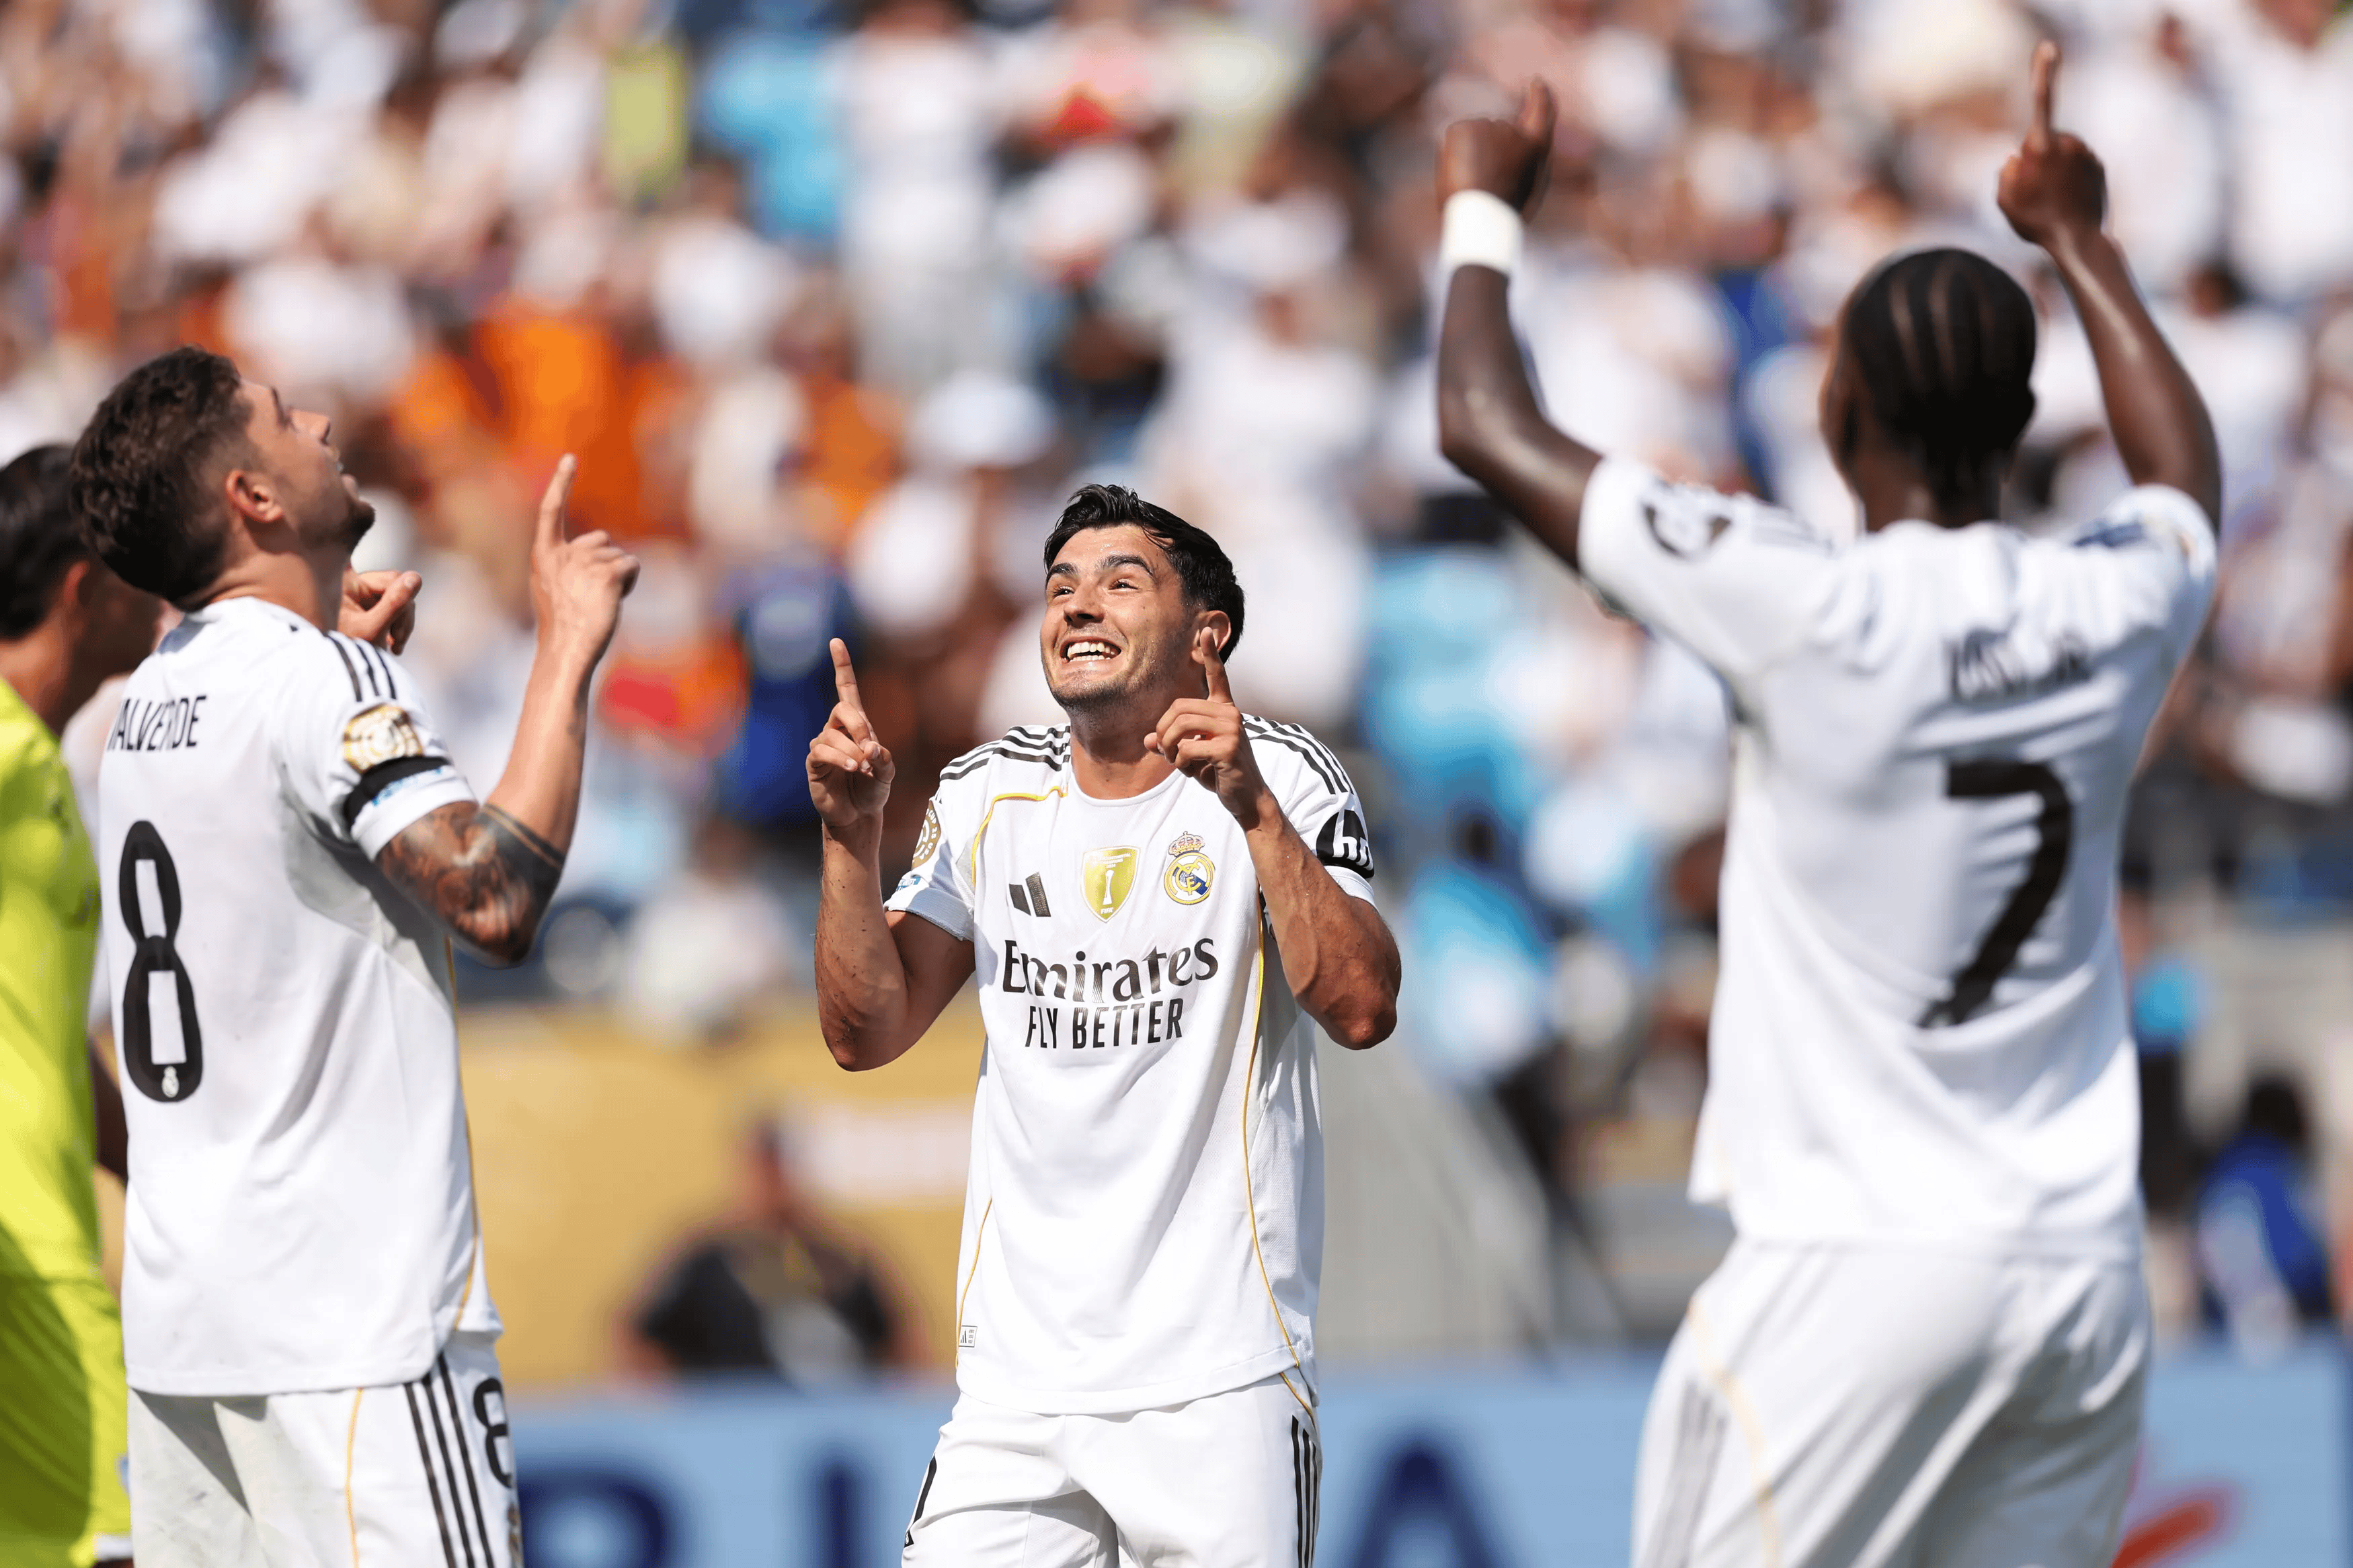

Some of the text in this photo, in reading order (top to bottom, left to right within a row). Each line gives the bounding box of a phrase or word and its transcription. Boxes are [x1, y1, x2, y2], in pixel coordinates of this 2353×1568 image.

[1101, 907, 1114, 915] FIFA
[1915, 759, 2073, 1028] 7
[120, 820, 202, 1102] 8
[1002, 938, 1219, 1003] Emirates
[1025, 998, 1183, 1049] FLY BETTER
